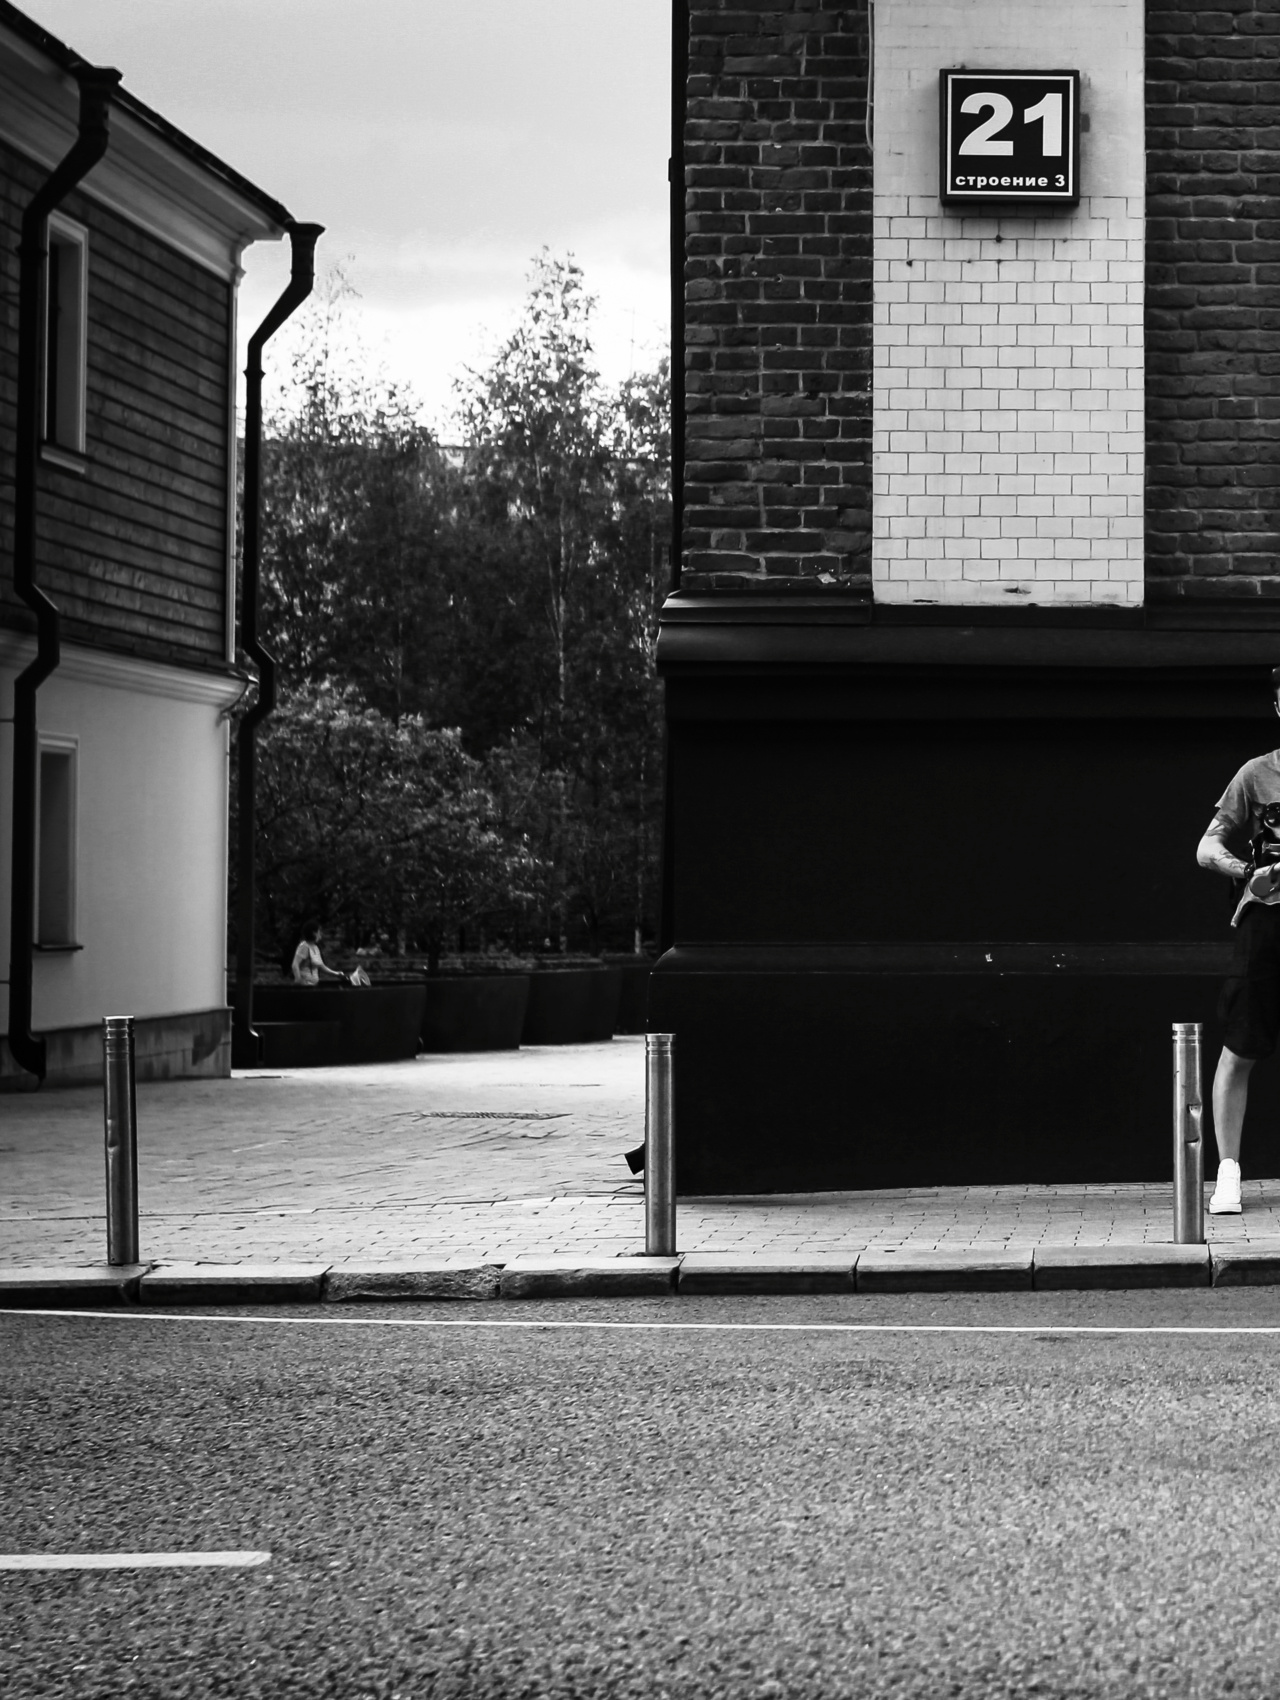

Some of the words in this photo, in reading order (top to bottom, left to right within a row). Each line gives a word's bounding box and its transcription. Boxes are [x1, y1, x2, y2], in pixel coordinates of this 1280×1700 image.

[958, 92, 1063, 157] 21
[955, 175, 1049, 189] строение
[1054, 174, 1066, 187] 3
